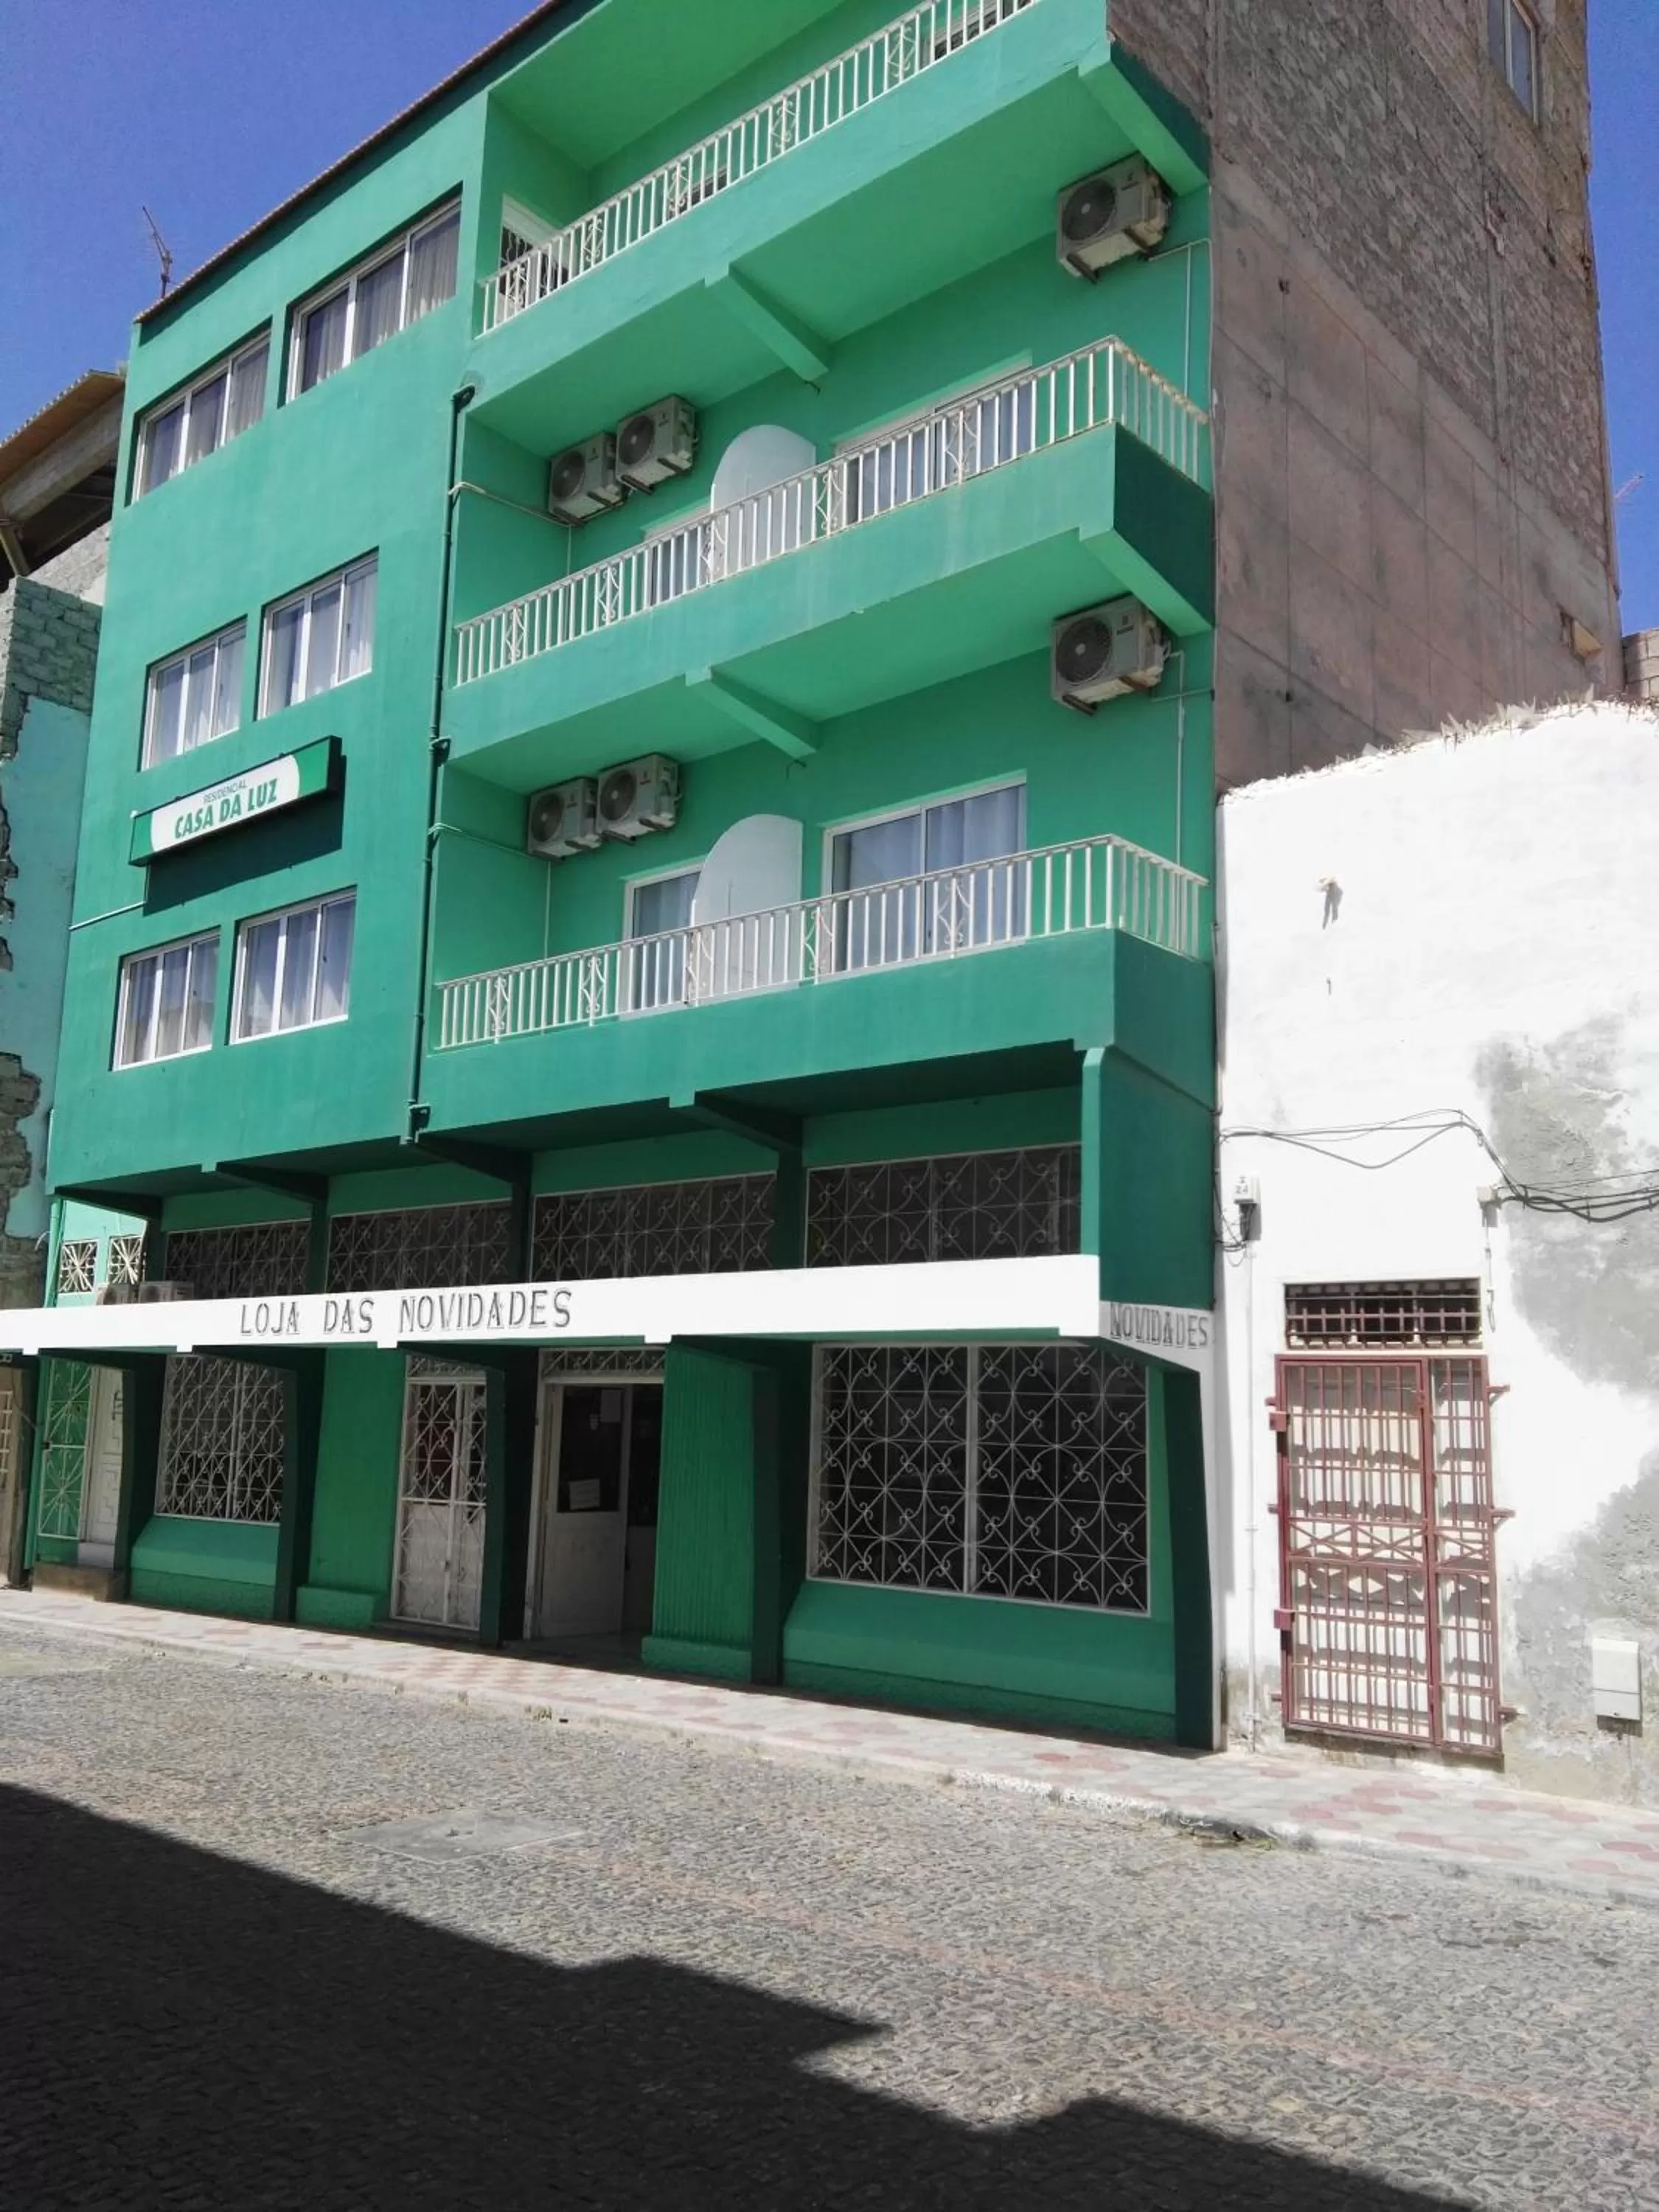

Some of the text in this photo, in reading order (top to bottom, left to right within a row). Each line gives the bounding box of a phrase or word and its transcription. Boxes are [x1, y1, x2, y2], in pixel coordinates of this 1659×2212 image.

[175, 779, 278, 838] CASA DA LUZ
[203, 779, 248, 804] RESIDENCIAL
[240, 1289, 572, 1335] LOJA DAS NOVIDADES
[1110, 1303, 1208, 1349] NOVIDADES
